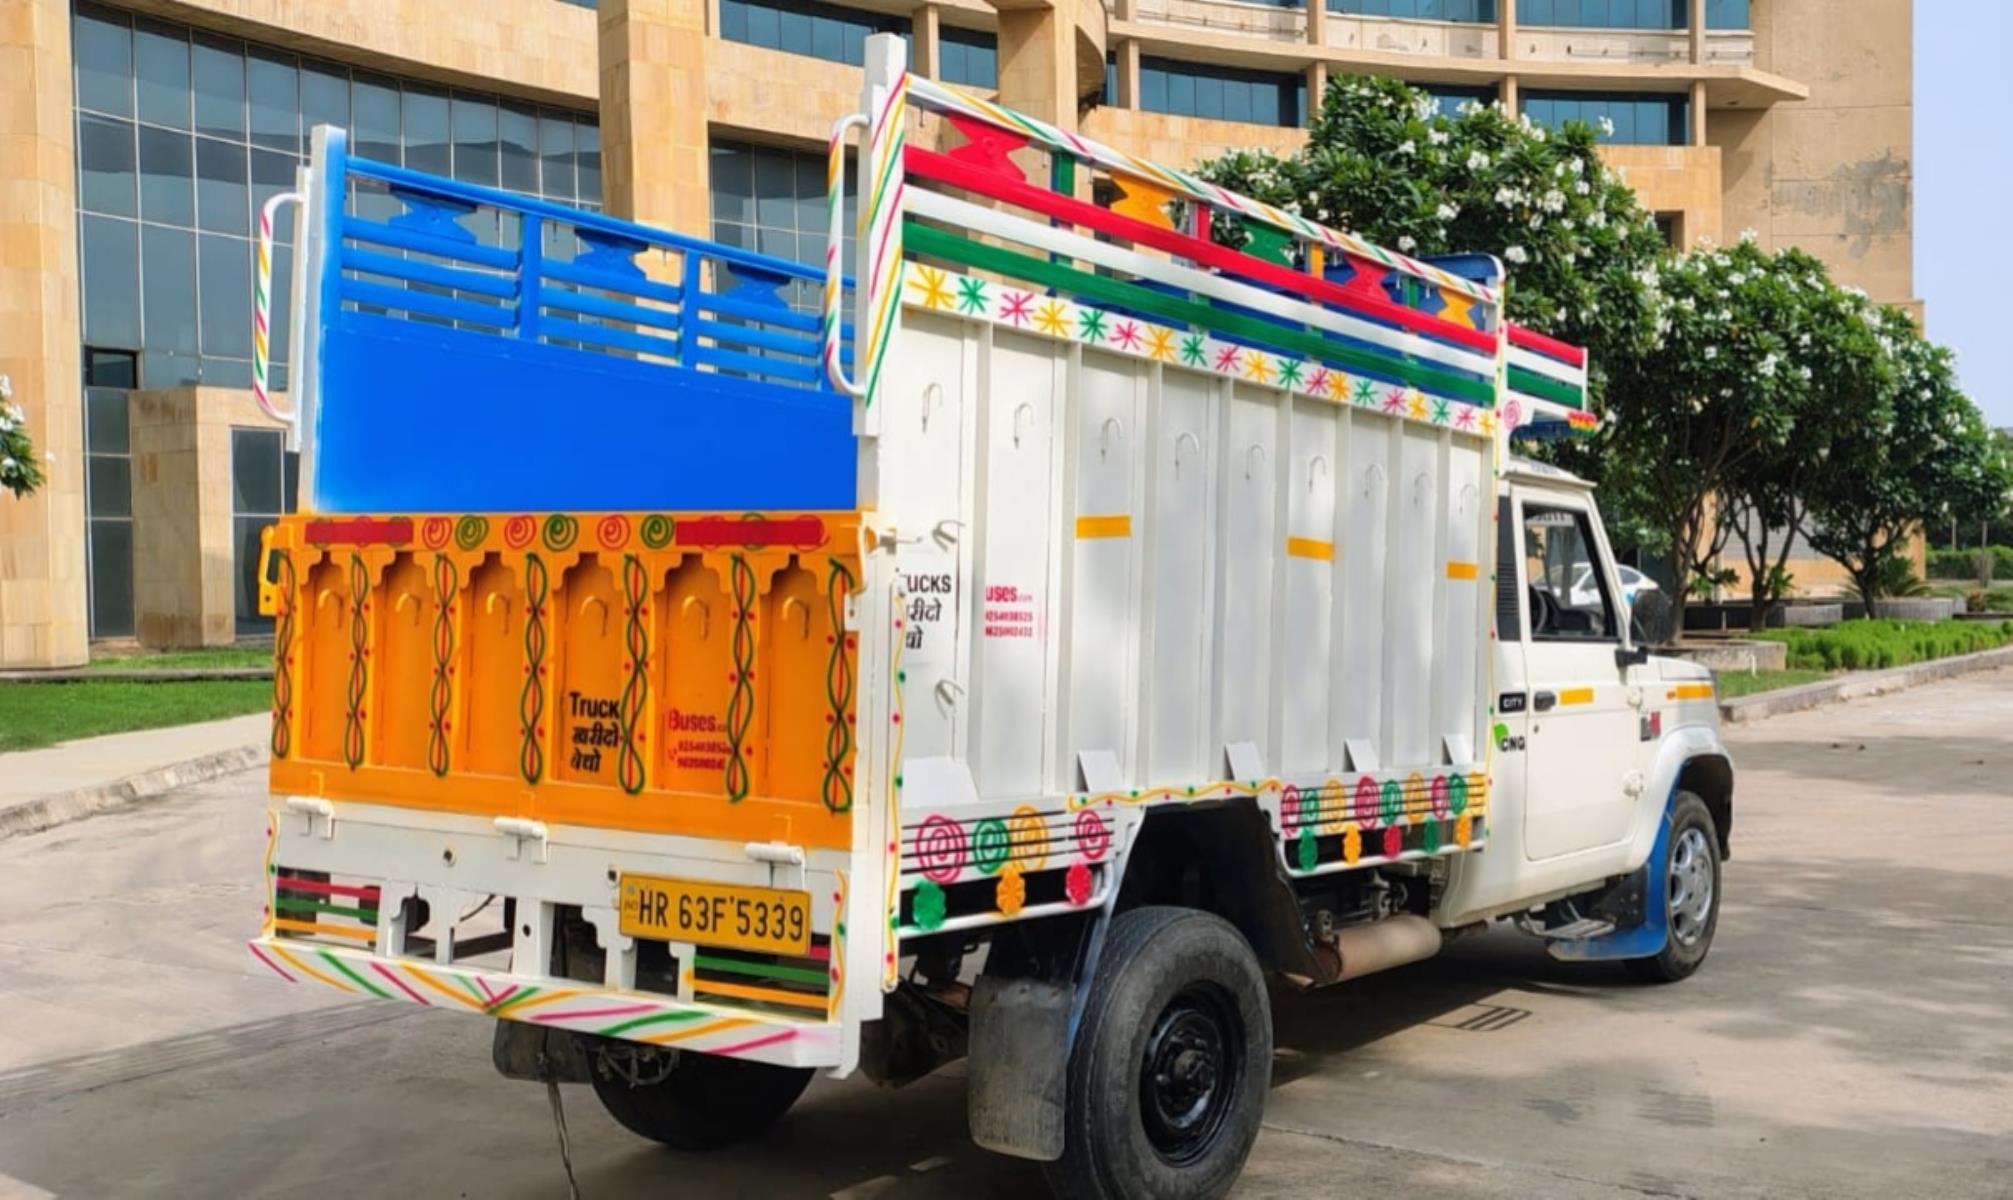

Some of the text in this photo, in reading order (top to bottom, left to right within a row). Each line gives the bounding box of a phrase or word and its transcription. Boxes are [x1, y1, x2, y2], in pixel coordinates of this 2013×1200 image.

[906, 574, 952, 594] UCKS
[906, 598, 942, 622] रीदो
[639, 889, 669, 928] HR
